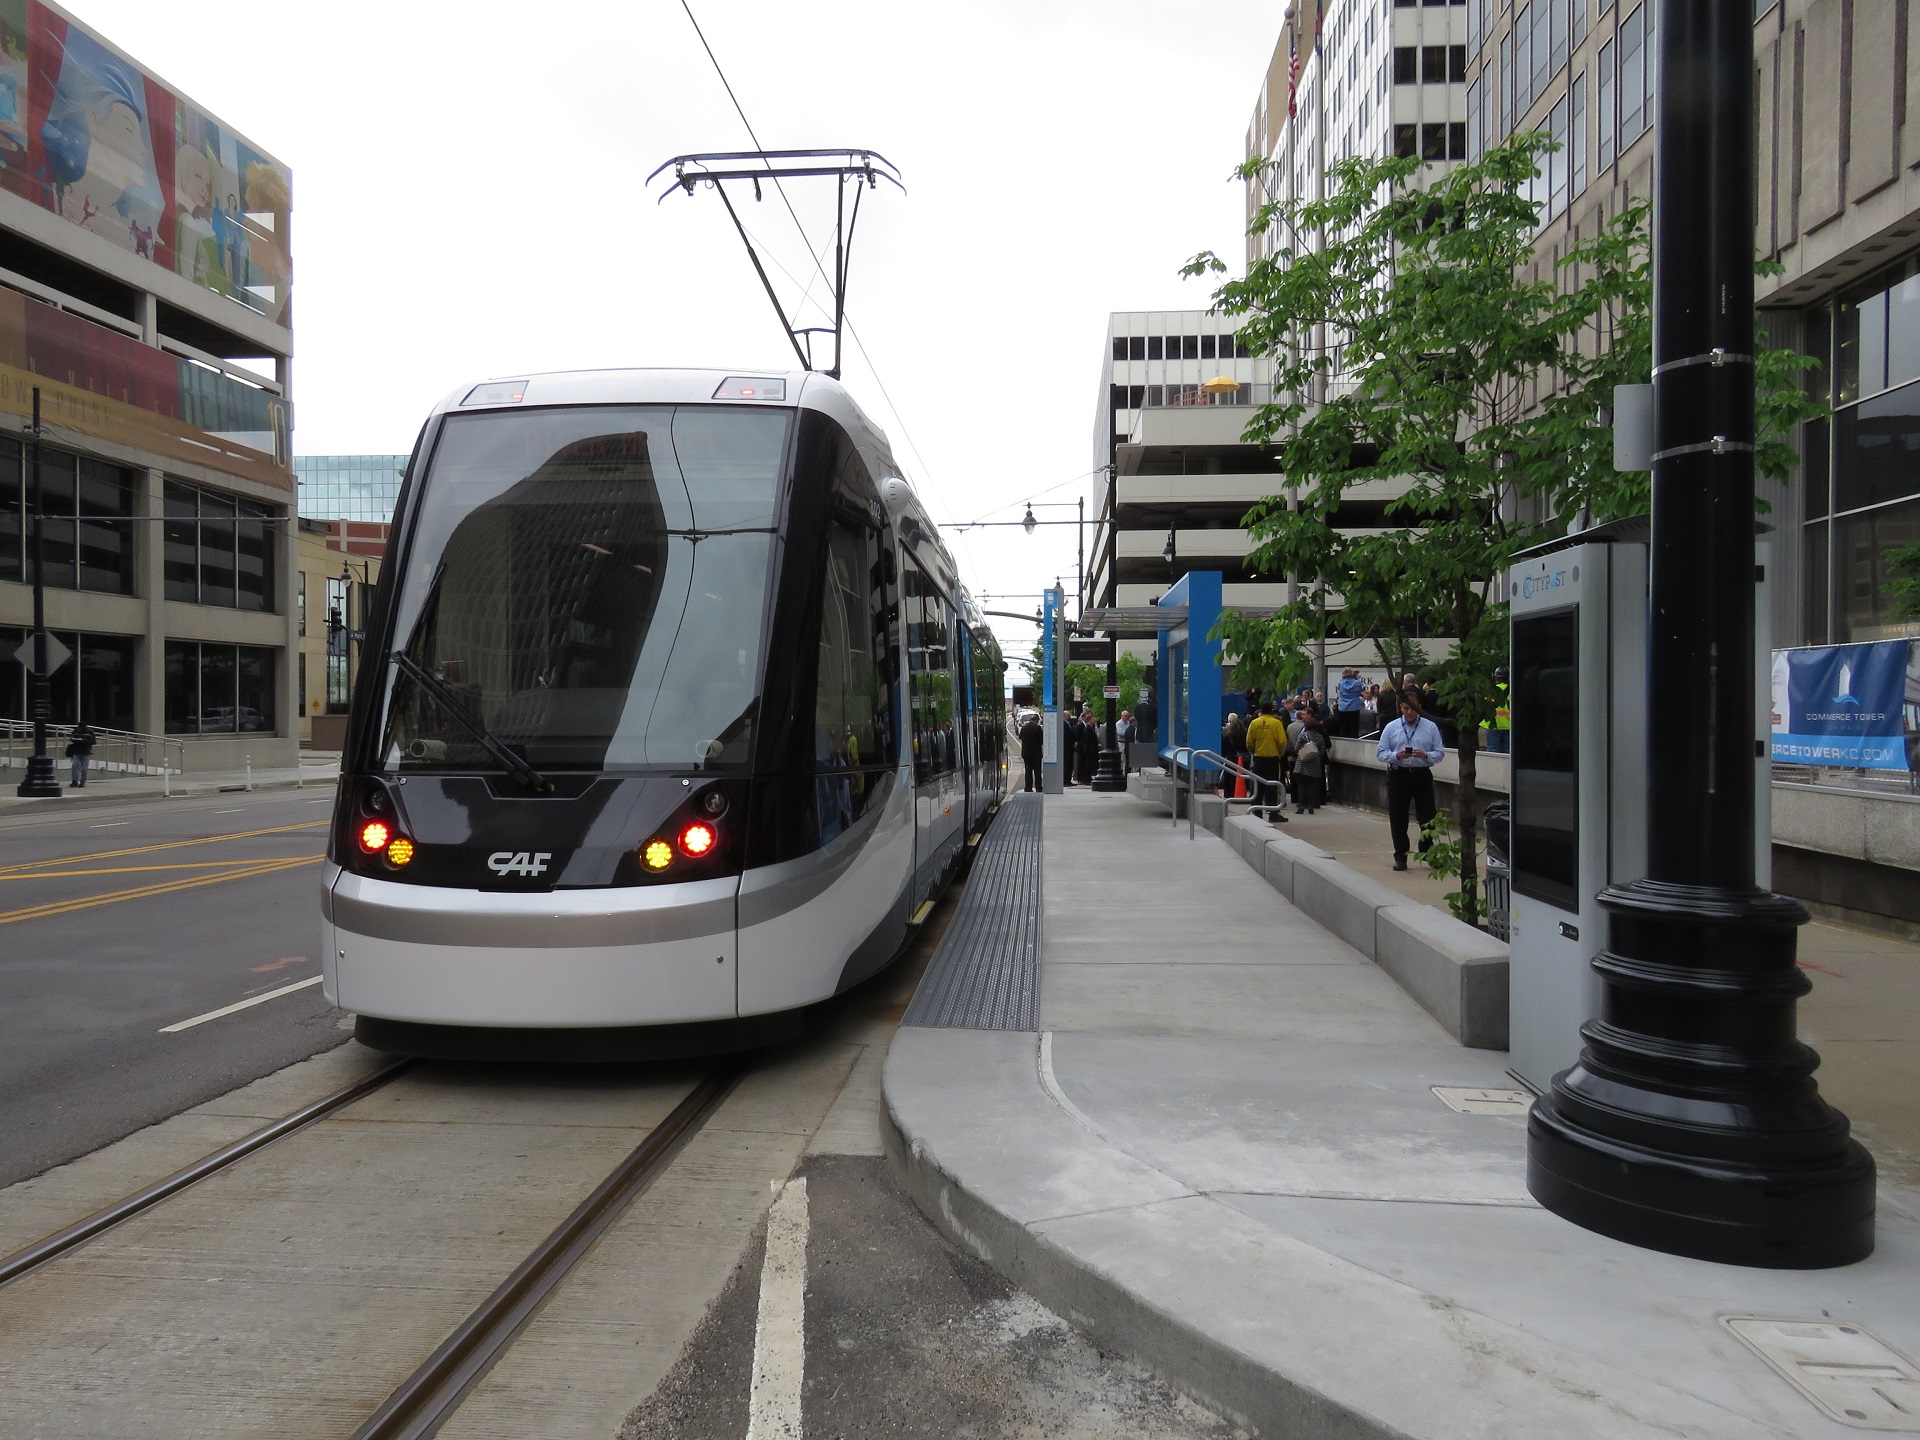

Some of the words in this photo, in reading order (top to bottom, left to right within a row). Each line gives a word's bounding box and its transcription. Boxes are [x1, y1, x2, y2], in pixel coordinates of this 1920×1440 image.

[1043, 644, 1051, 670] Library
[1805, 712, 1851, 721] COMMERCE
[1853, 712, 1886, 721] TOWER
[488, 852, 552, 876] CAF
